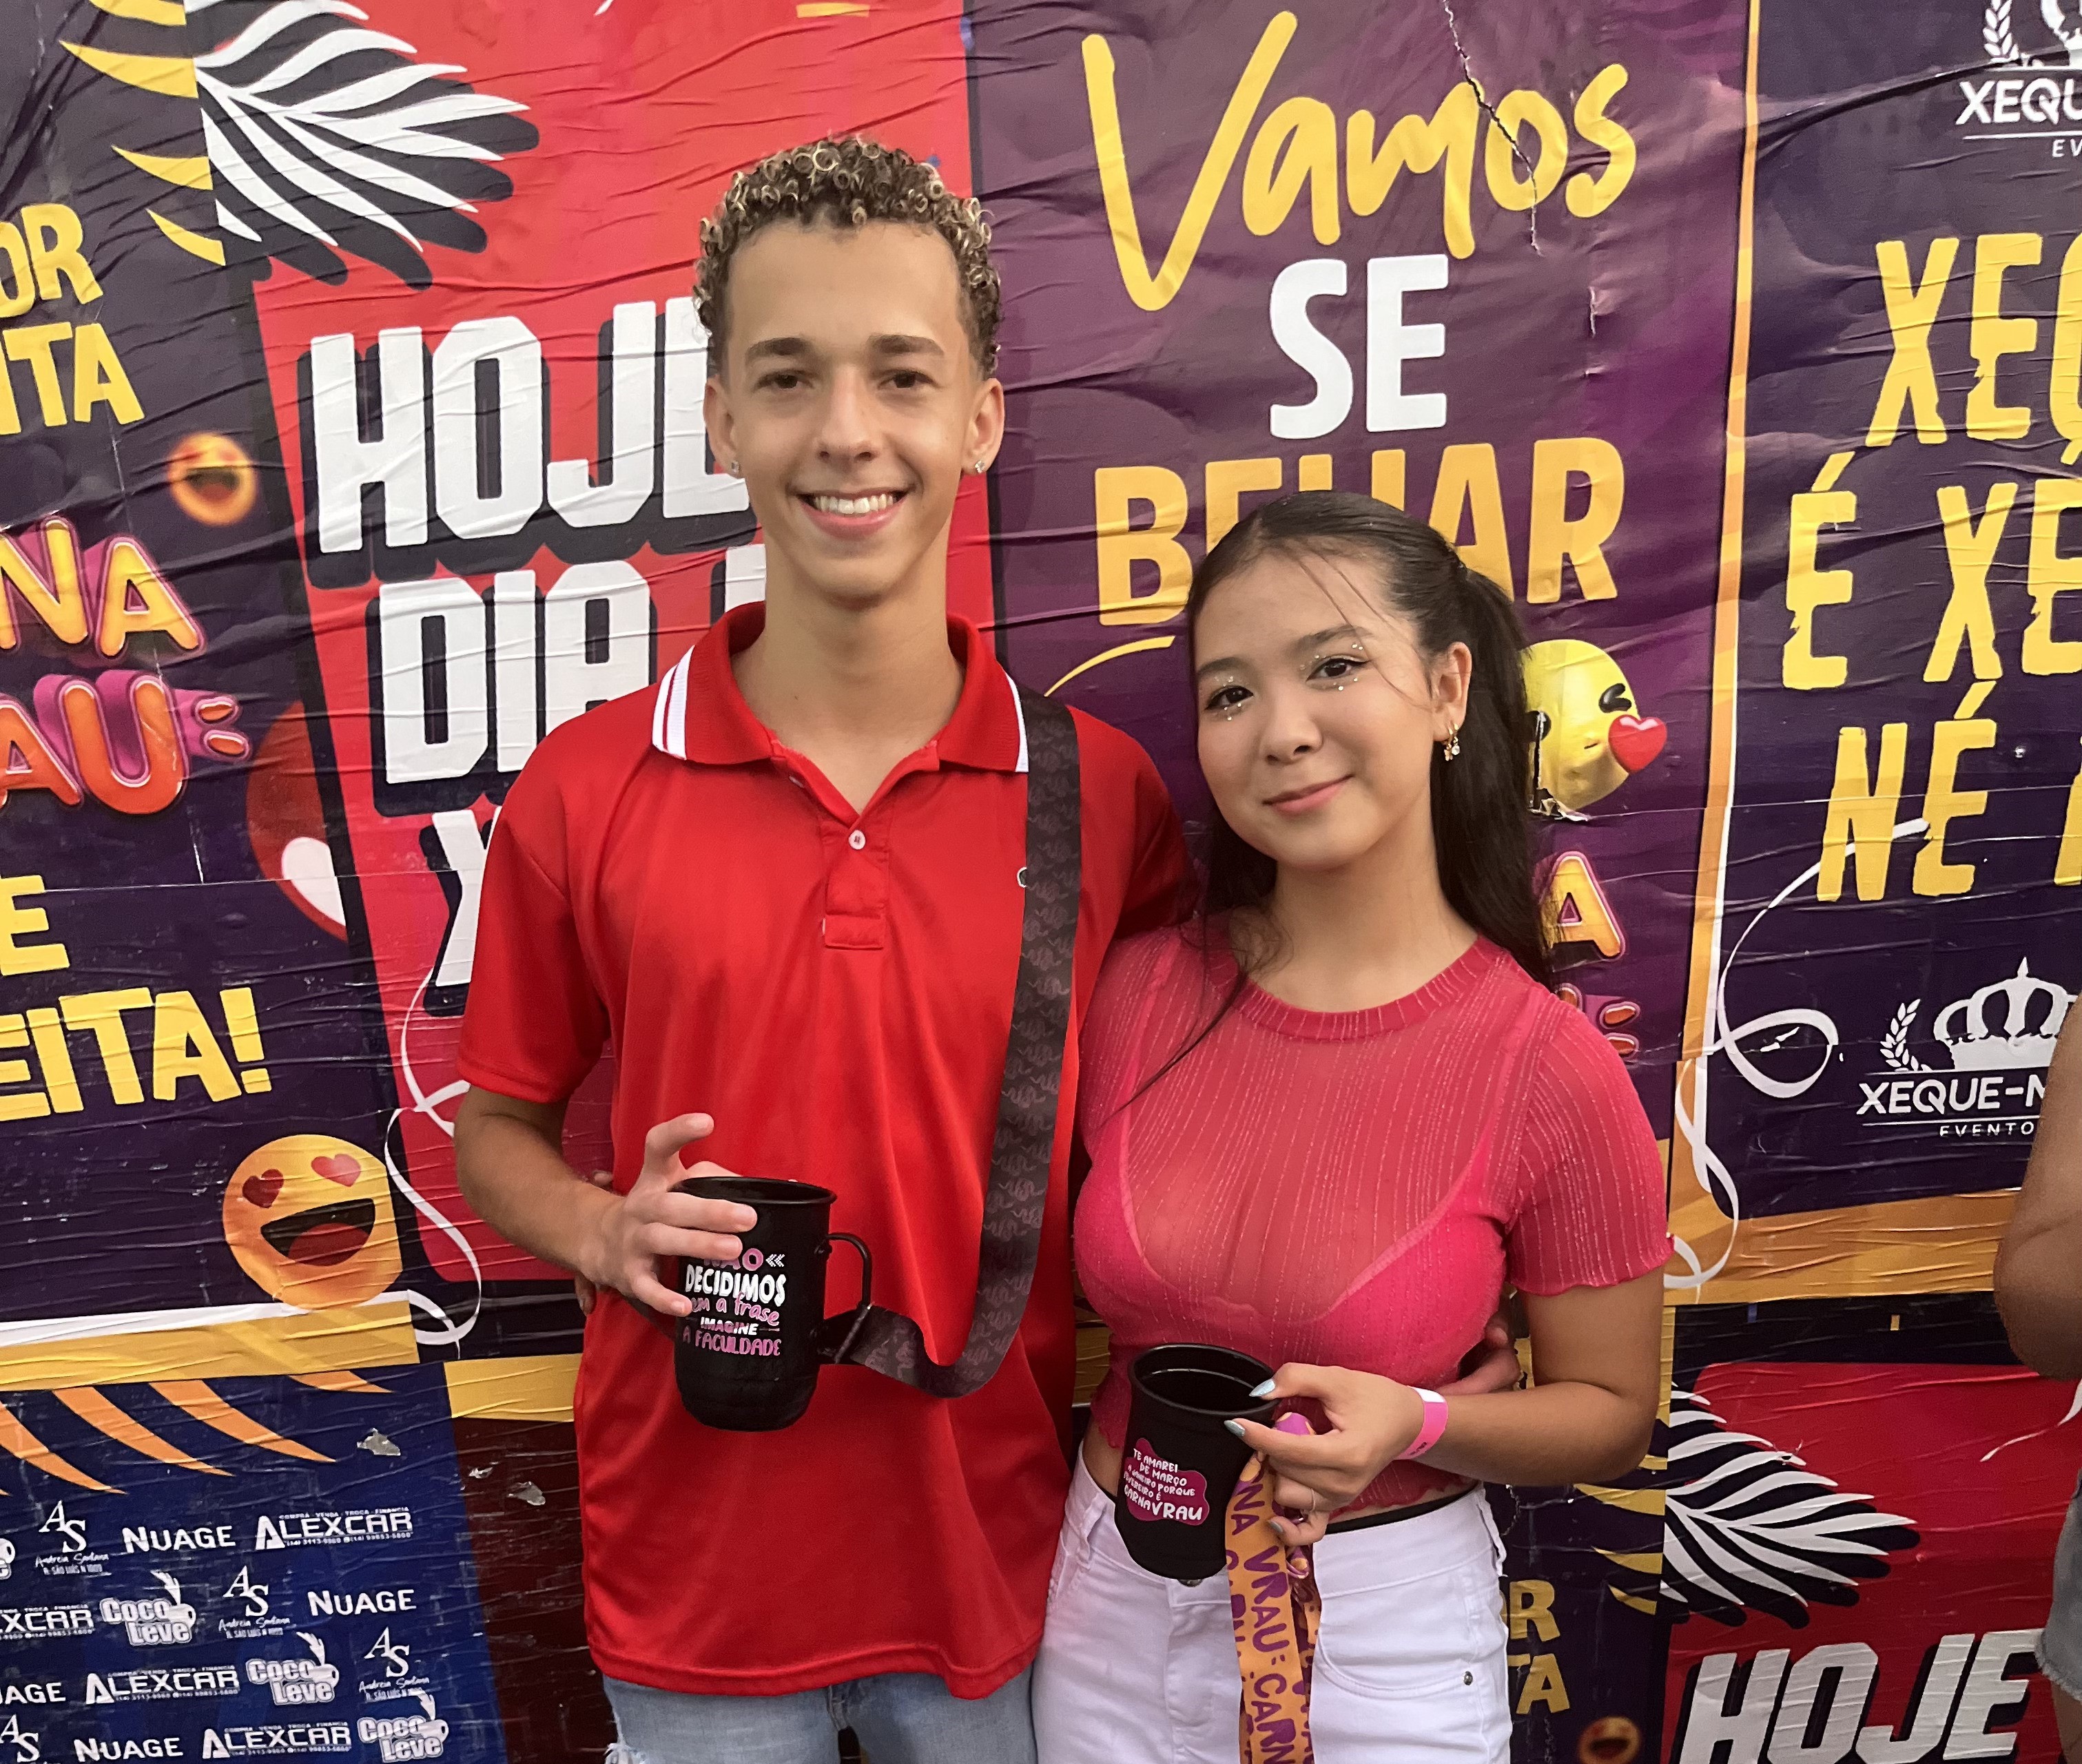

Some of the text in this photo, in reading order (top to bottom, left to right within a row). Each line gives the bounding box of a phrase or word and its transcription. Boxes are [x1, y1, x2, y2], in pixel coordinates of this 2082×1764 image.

[1082, 11, 1636, 311] Vamos
[1270, 253, 1449, 439] SE
[1782, 451, 1856, 689] É
[379, 559, 650, 784] DIA
[1816, 681, 1997, 902] NÉ
[686, 1264, 786, 1307] DECIDIMOS
[716, 1298, 727, 1313] a
[734, 1291, 780, 1326] frase
[701, 1316, 759, 1336] IMAGINE
[695, 1329, 782, 1356] FACULDADE
[1133, 1449, 1178, 1473] TE AMAREI
[1140, 1462, 1187, 1486] DE MARÇO
[1157, 1484, 1195, 1496] PORQUE
[122, 1526, 236, 1553] NUAGE
[256, 1513, 412, 1550] ALEXCAR
[307, 1589, 416, 1616] NUAGE
[0, 1609, 94, 1634] XCAR
[0, 1682, 66, 1705] AGE
[86, 1671, 240, 1705] ALEXCAR
[1679, 1628, 2045, 1764] HOJE
[74, 1737, 184, 1763] NUAGE
[203, 1727, 351, 1759] ALEXCAR
